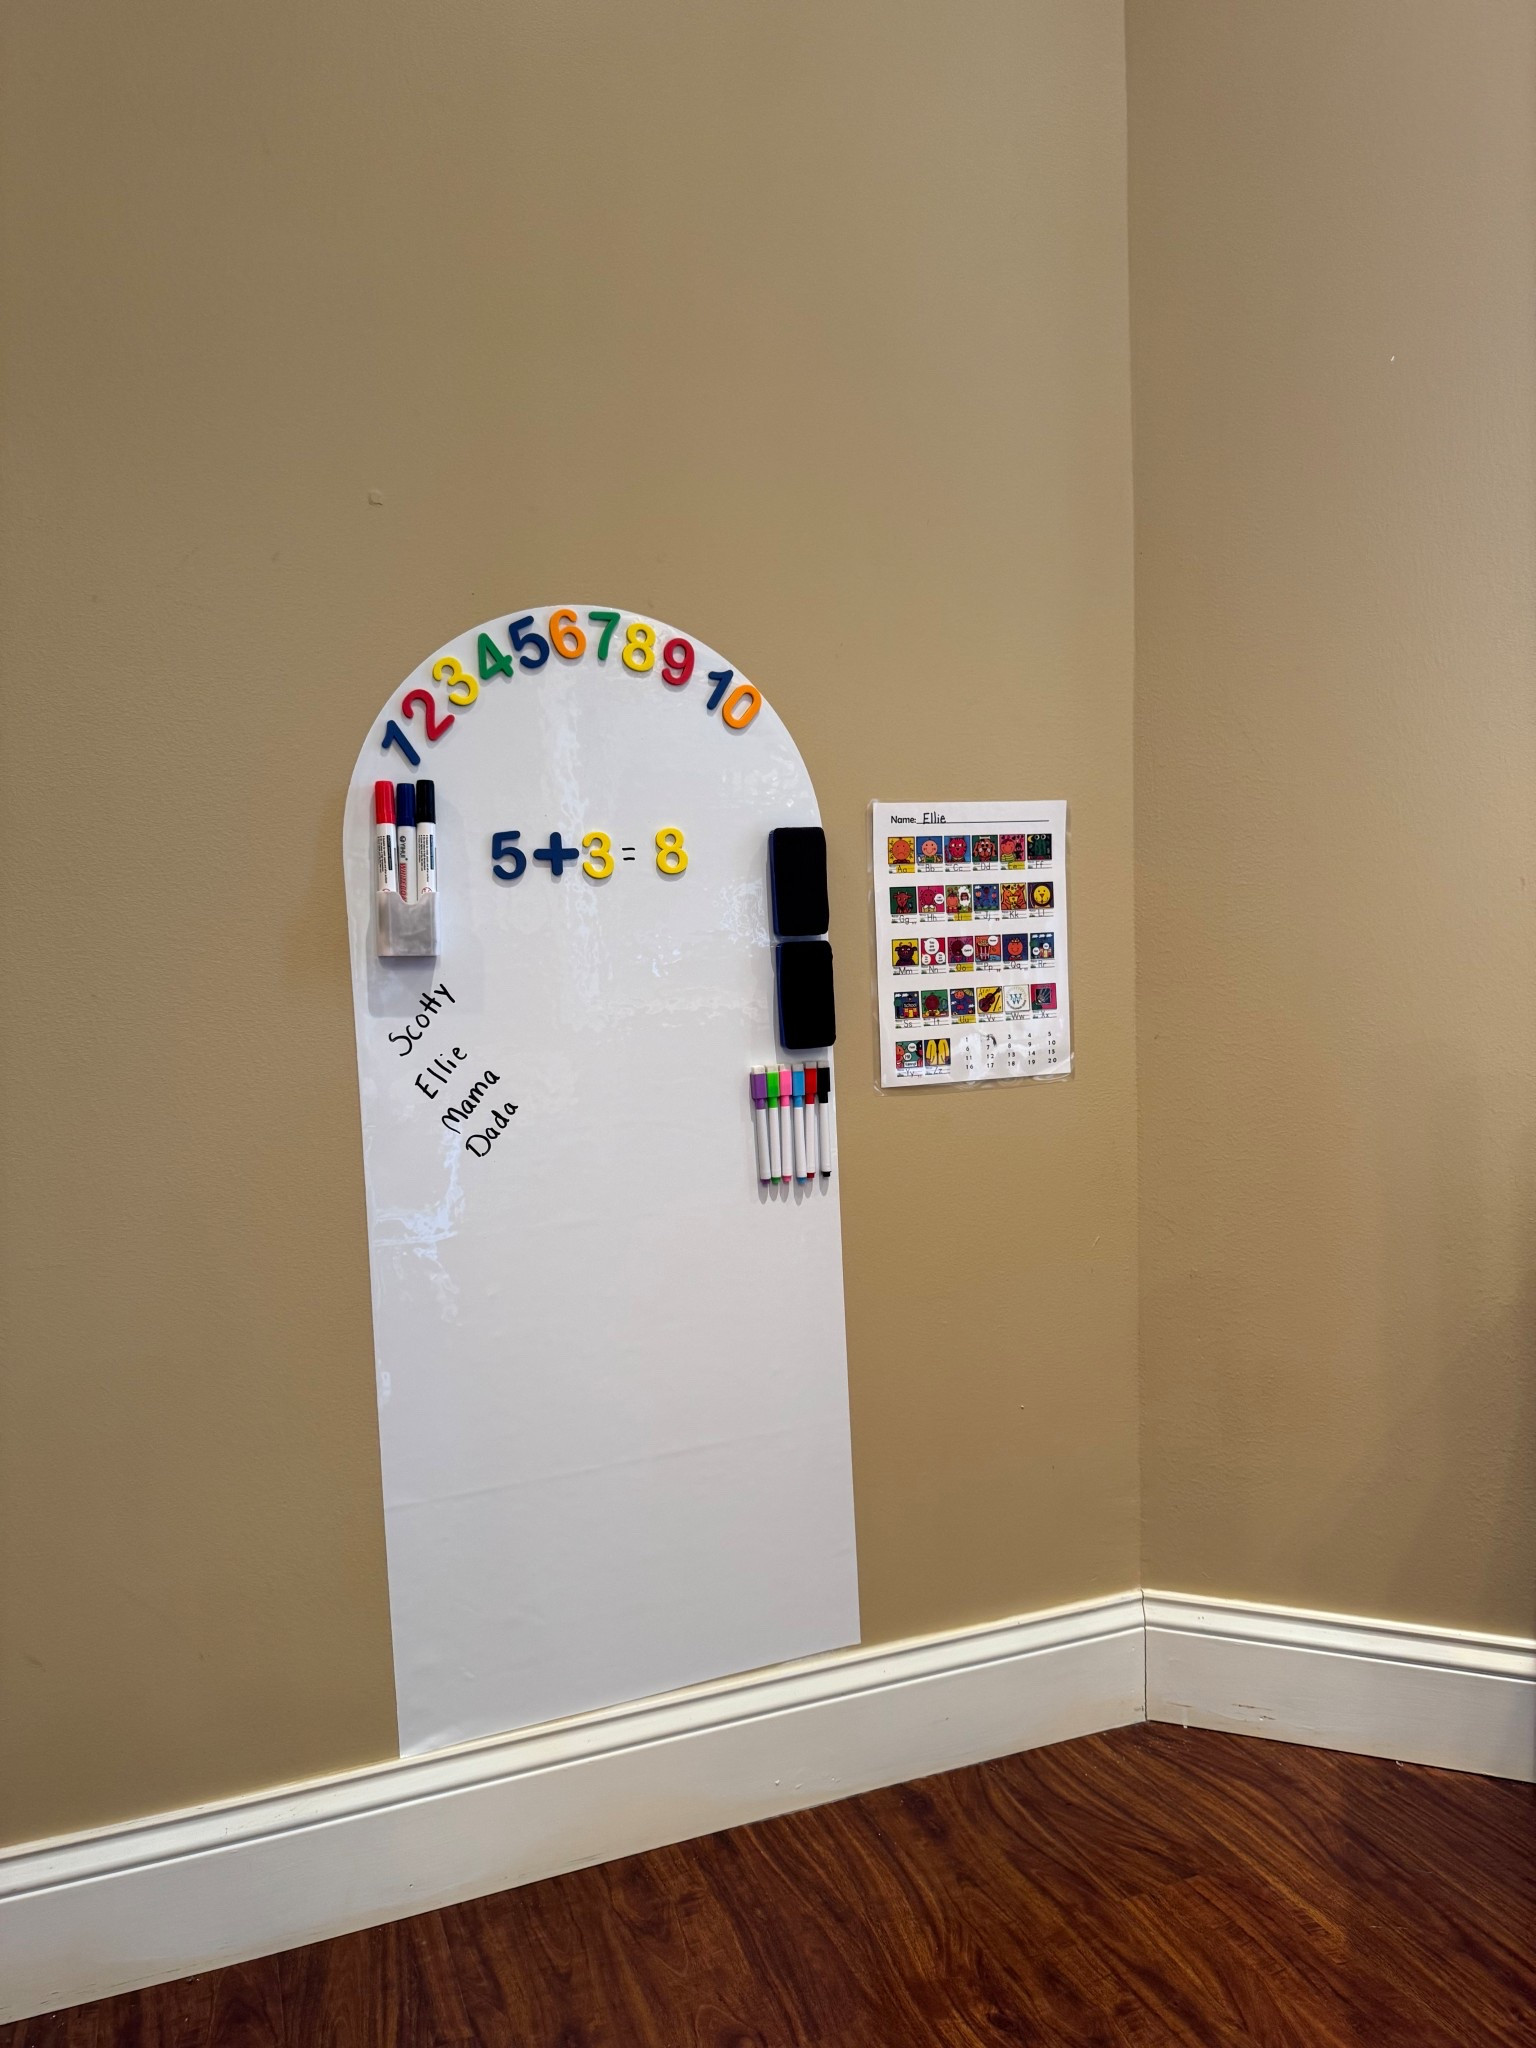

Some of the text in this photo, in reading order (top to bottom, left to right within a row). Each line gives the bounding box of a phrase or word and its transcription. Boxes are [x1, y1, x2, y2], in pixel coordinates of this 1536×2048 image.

[382, 608, 762, 766] 1 2 3 4 5 6 7 8 9 10
[891, 811, 946, 824] Name: Ellie
[655, 828, 688, 875] 8
[897, 864, 908, 873] Aa
[925, 863, 935, 872] Bb
[953, 863, 963, 872] Cc
[981, 862, 991, 870] Dd
[1035, 860, 1043, 869] Ff
[899, 914, 909, 925] Gg
[927, 913, 937, 922] Hh
[984, 911, 991, 921] Jj
[1009, 910, 1019, 919] Kk
[899, 966, 913, 975] Mm
[928, 965, 939, 973] Nn
[956, 963, 967, 971] Oo
[984, 962, 993, 972] Pp
[388, 983, 456, 1057] Scotty
[904, 1020, 913, 1028] Ss
[987, 1014, 996, 1022] Vv
[1011, 1011, 1025, 1020] Ww
[414, 1046, 468, 1099] Ellie
[934, 1066, 943, 1075] Zz
[441, 1070, 501, 1134] Mama
[465, 1102, 519, 1158] Dada
